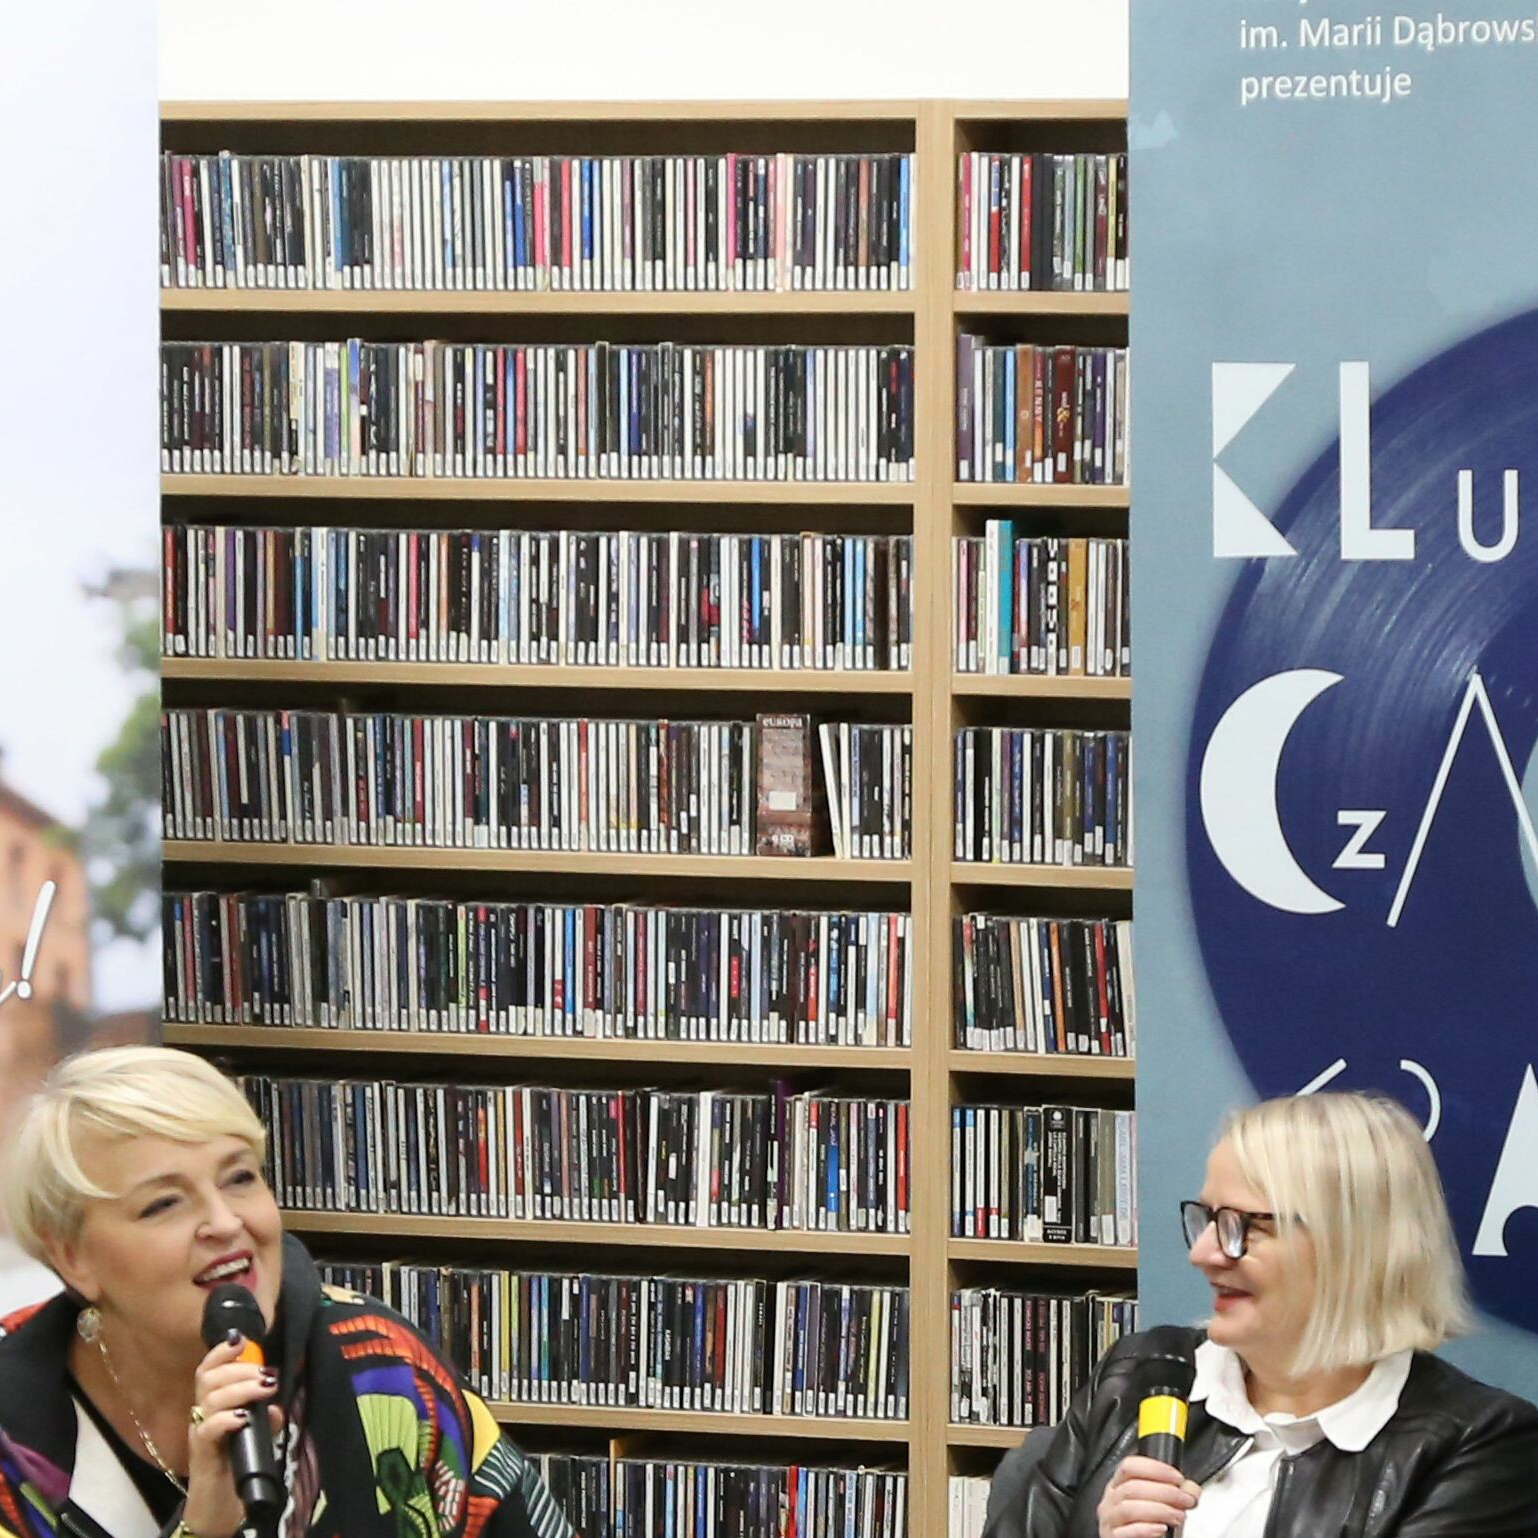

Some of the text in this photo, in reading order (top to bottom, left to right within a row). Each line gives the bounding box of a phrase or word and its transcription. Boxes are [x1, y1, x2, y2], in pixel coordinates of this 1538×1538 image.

[1239, 18, 1288, 49] im.
[1299, 13, 1383, 48] Marii
[1240, 64, 1413, 106] prezentuje
[1034, 380, 1043, 422] KENNY
